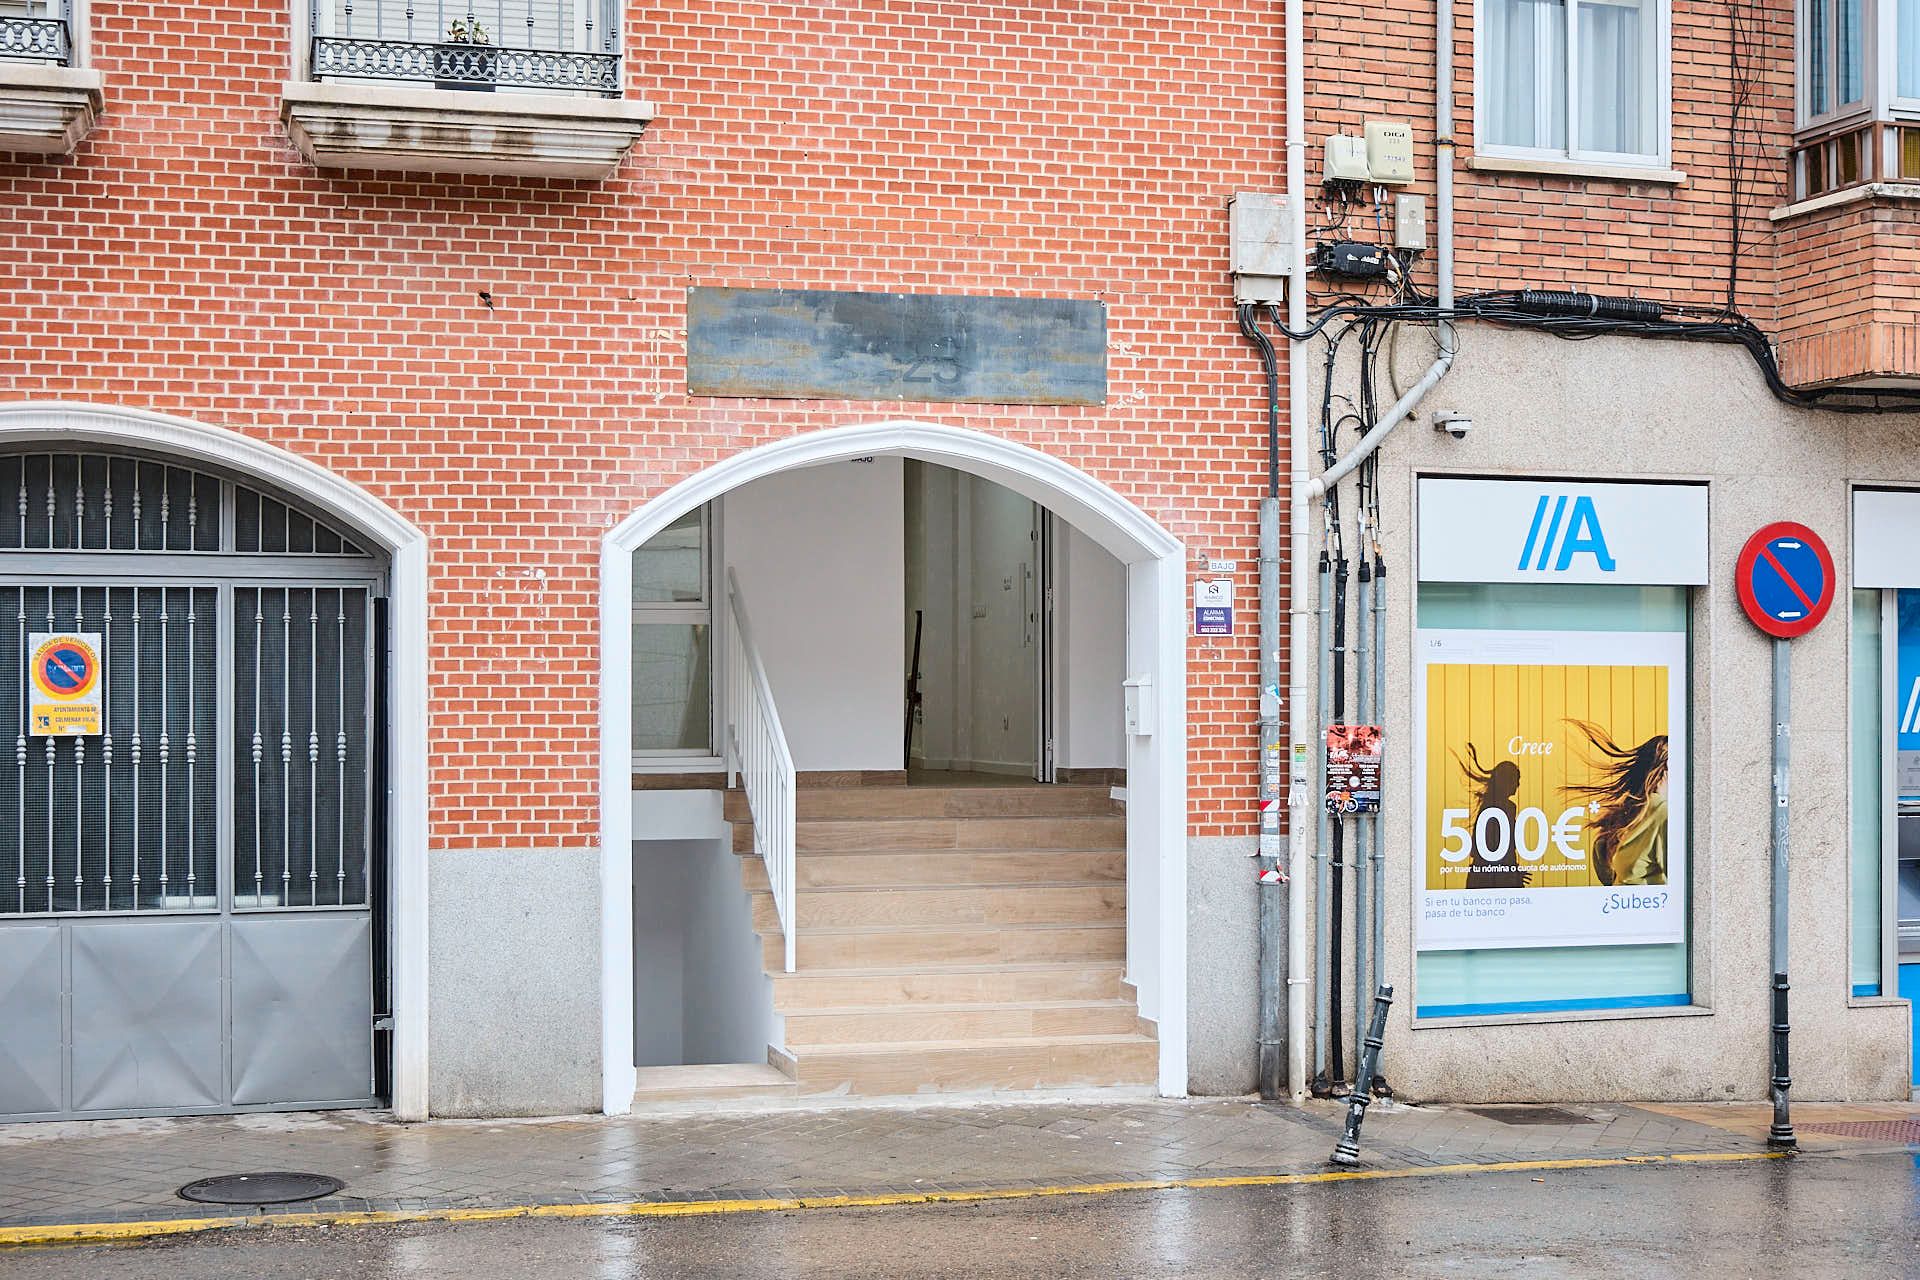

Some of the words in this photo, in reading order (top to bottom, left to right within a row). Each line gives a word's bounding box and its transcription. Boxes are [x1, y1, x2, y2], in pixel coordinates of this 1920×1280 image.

[1211, 562, 1234, 570] BAJO
[34, 642, 53, 658] ALIDA
[1507, 736, 1553, 755] Crece
[1440, 866, 1453, 875] por
[1454, 865, 1471, 873] traer
[1472, 865, 1481, 873] tu
[1482, 863, 1509, 873] nómina
[1517, 864, 1538, 872] cuota
[1538, 863, 1549, 872] de
[1550, 863, 1587, 871] autónomo
[1425, 898, 1433, 907] Si
[1435, 898, 1448, 906] en
[1450, 898, 1460, 906] tu
[1463, 897, 1492, 906] banco
[1602, 892, 1668, 914] ¿Subes?
[1425, 910, 1447, 920] pasa
[1449, 909, 1461, 917] de
[1463, 908, 1473, 917] tu
[1475, 907, 1505, 917] banco
